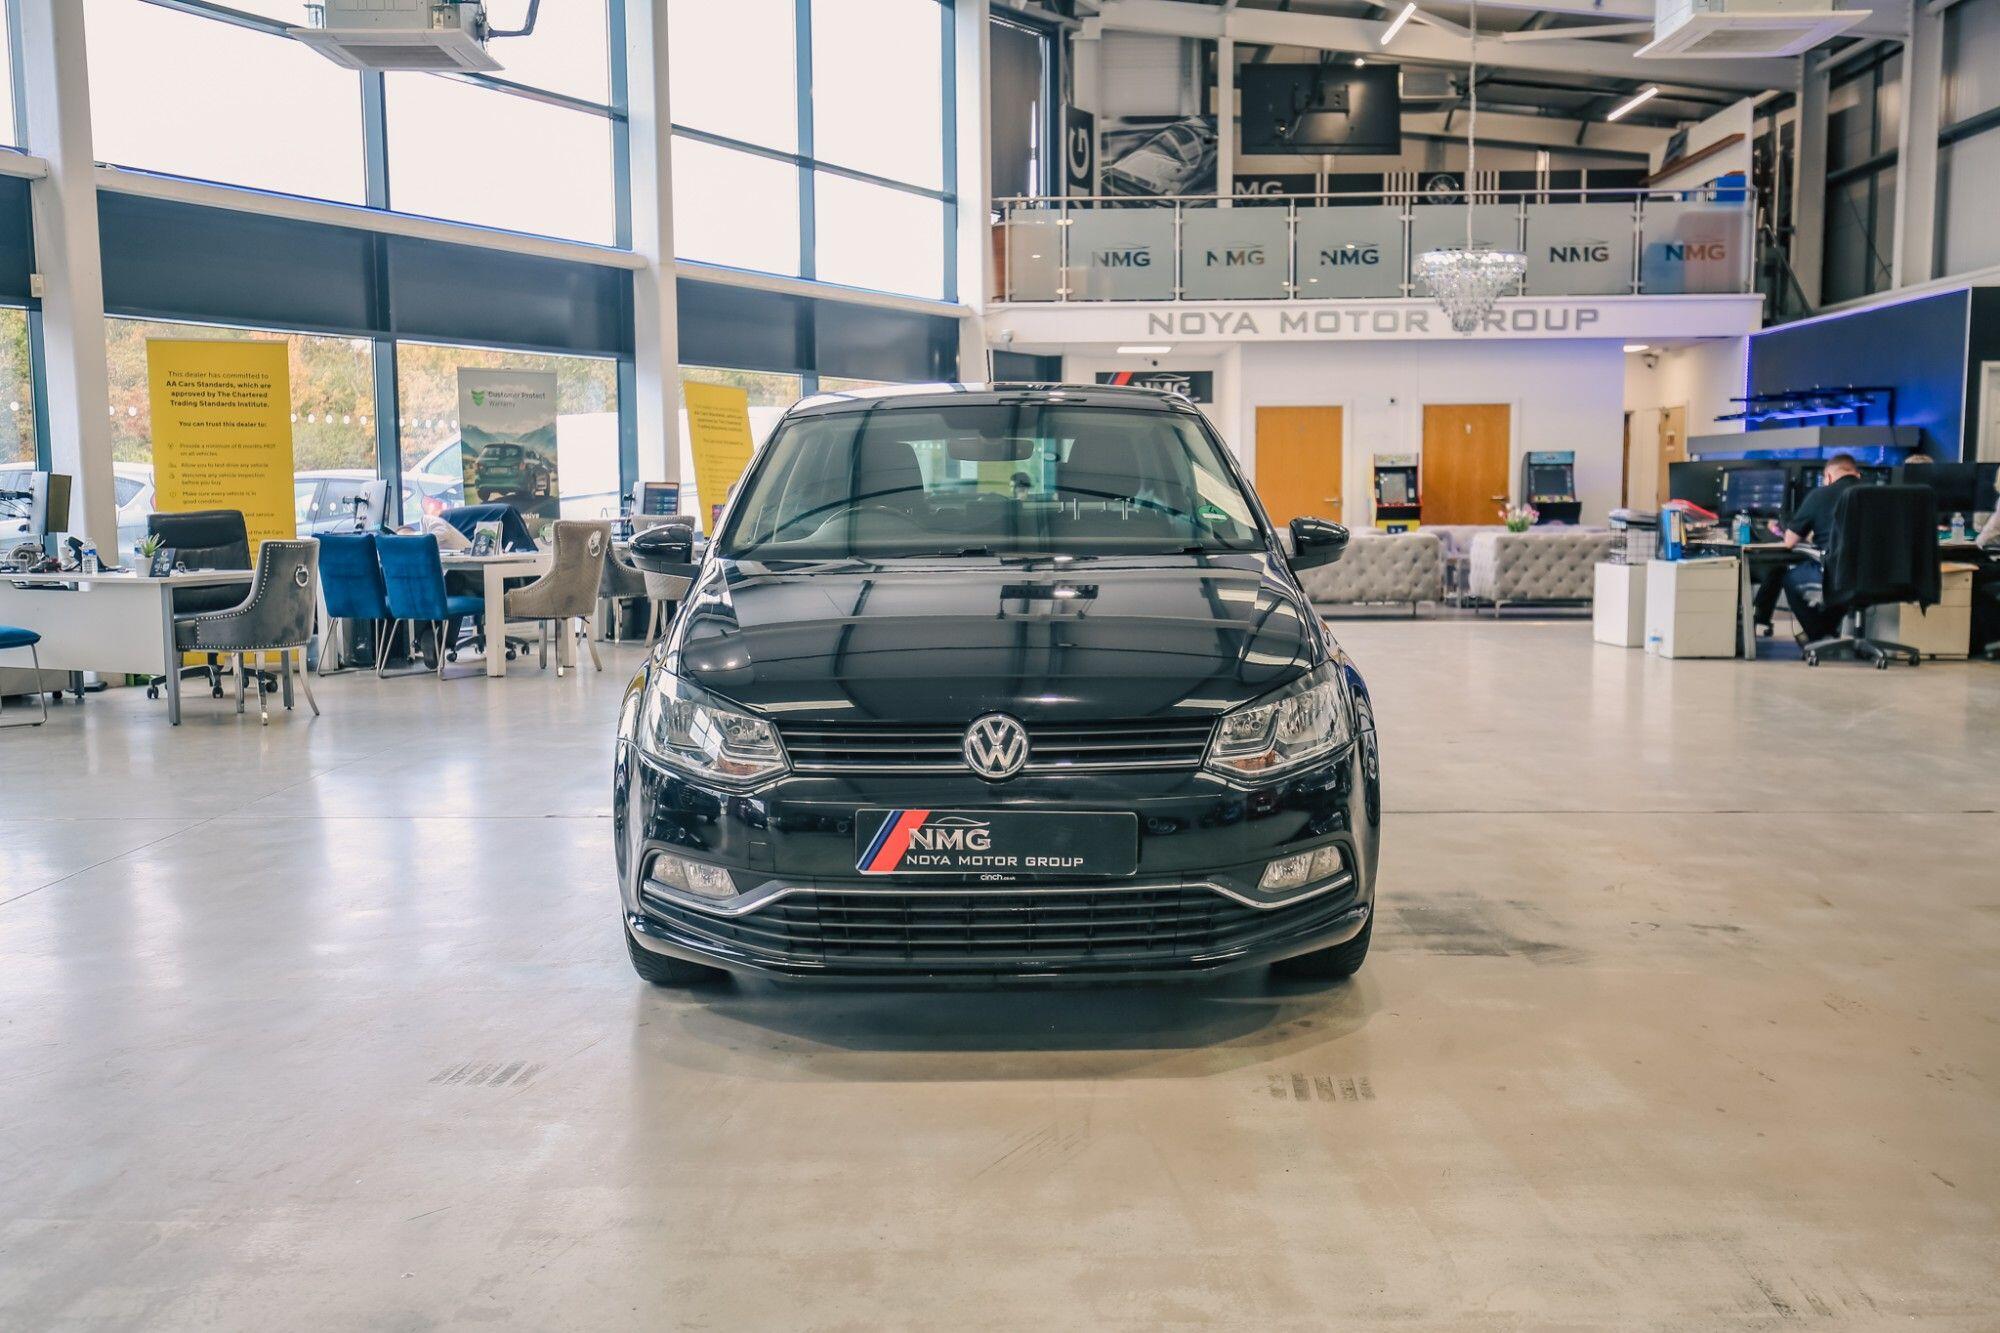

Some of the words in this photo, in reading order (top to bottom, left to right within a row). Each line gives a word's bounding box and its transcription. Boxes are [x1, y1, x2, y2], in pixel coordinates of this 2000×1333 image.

[1092, 251, 1151, 267] NMG
[1207, 250, 1265, 266] NMG
[1320, 250, 1379, 266] NMG
[1550, 246, 1609, 262] NMG
[1665, 244, 1725, 261] NMG
[1149, 311, 1259, 335] NOYA
[1280, 310, 1429, 334] MOTOR
[184, 371, 206, 379] dealer
[222, 372, 260, 380] committed
[238, 382, 258, 390] which
[171, 391, 206, 399] approved
[207, 391, 216, 399] by
[170, 400, 198, 408] Trading
[199, 400, 236, 408] Standards
[908, 828, 991, 850] NMG
[906, 855, 951, 866] NOYA
[958, 855, 1018, 867] MOTOR
[1025, 856, 1084, 868] GROUP
